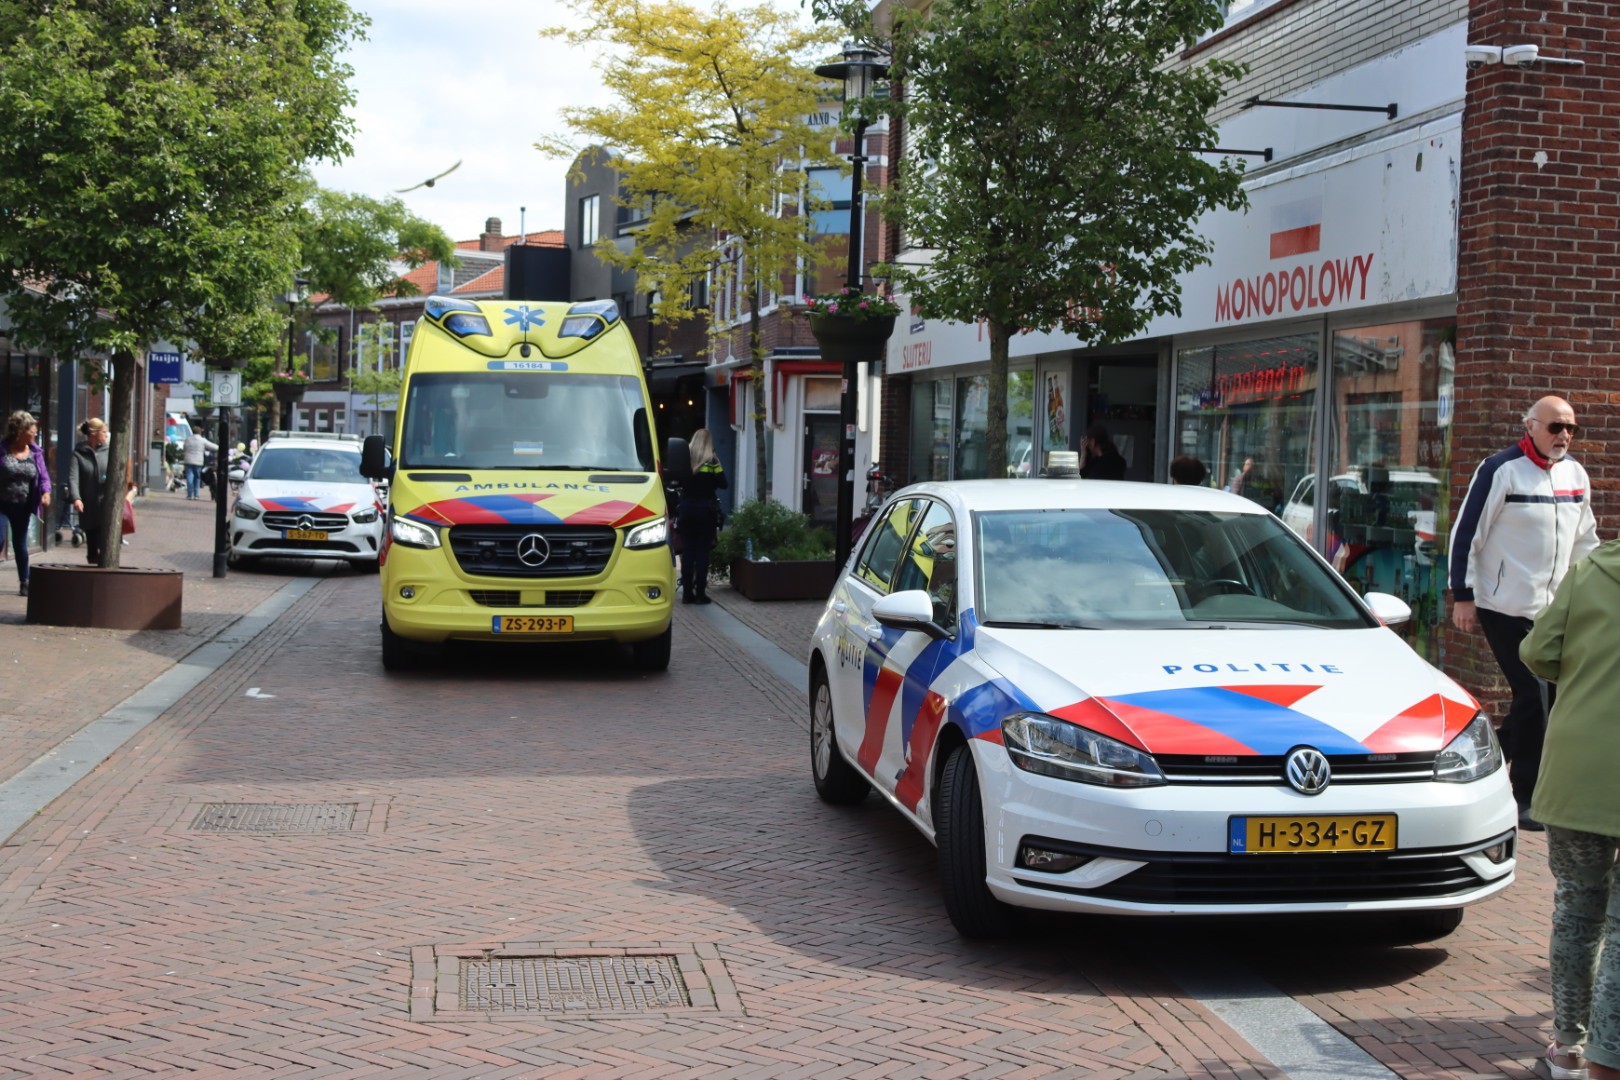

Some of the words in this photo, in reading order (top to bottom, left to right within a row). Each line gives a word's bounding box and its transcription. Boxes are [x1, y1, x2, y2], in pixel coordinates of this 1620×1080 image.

[807, 111, 829, 126] ANNO
[1215, 253, 1374, 322] MONOPOLOWY
[151, 353, 179, 364] Tuijn
[454, 482, 610, 493] AMBULANCE
[505, 618, 567, 631] ZS-293-P
[837, 635, 862, 670] POLITIE
[1162, 663, 1344, 675] POLITIE
[1259, 820, 1386, 847] H-334-GZ
